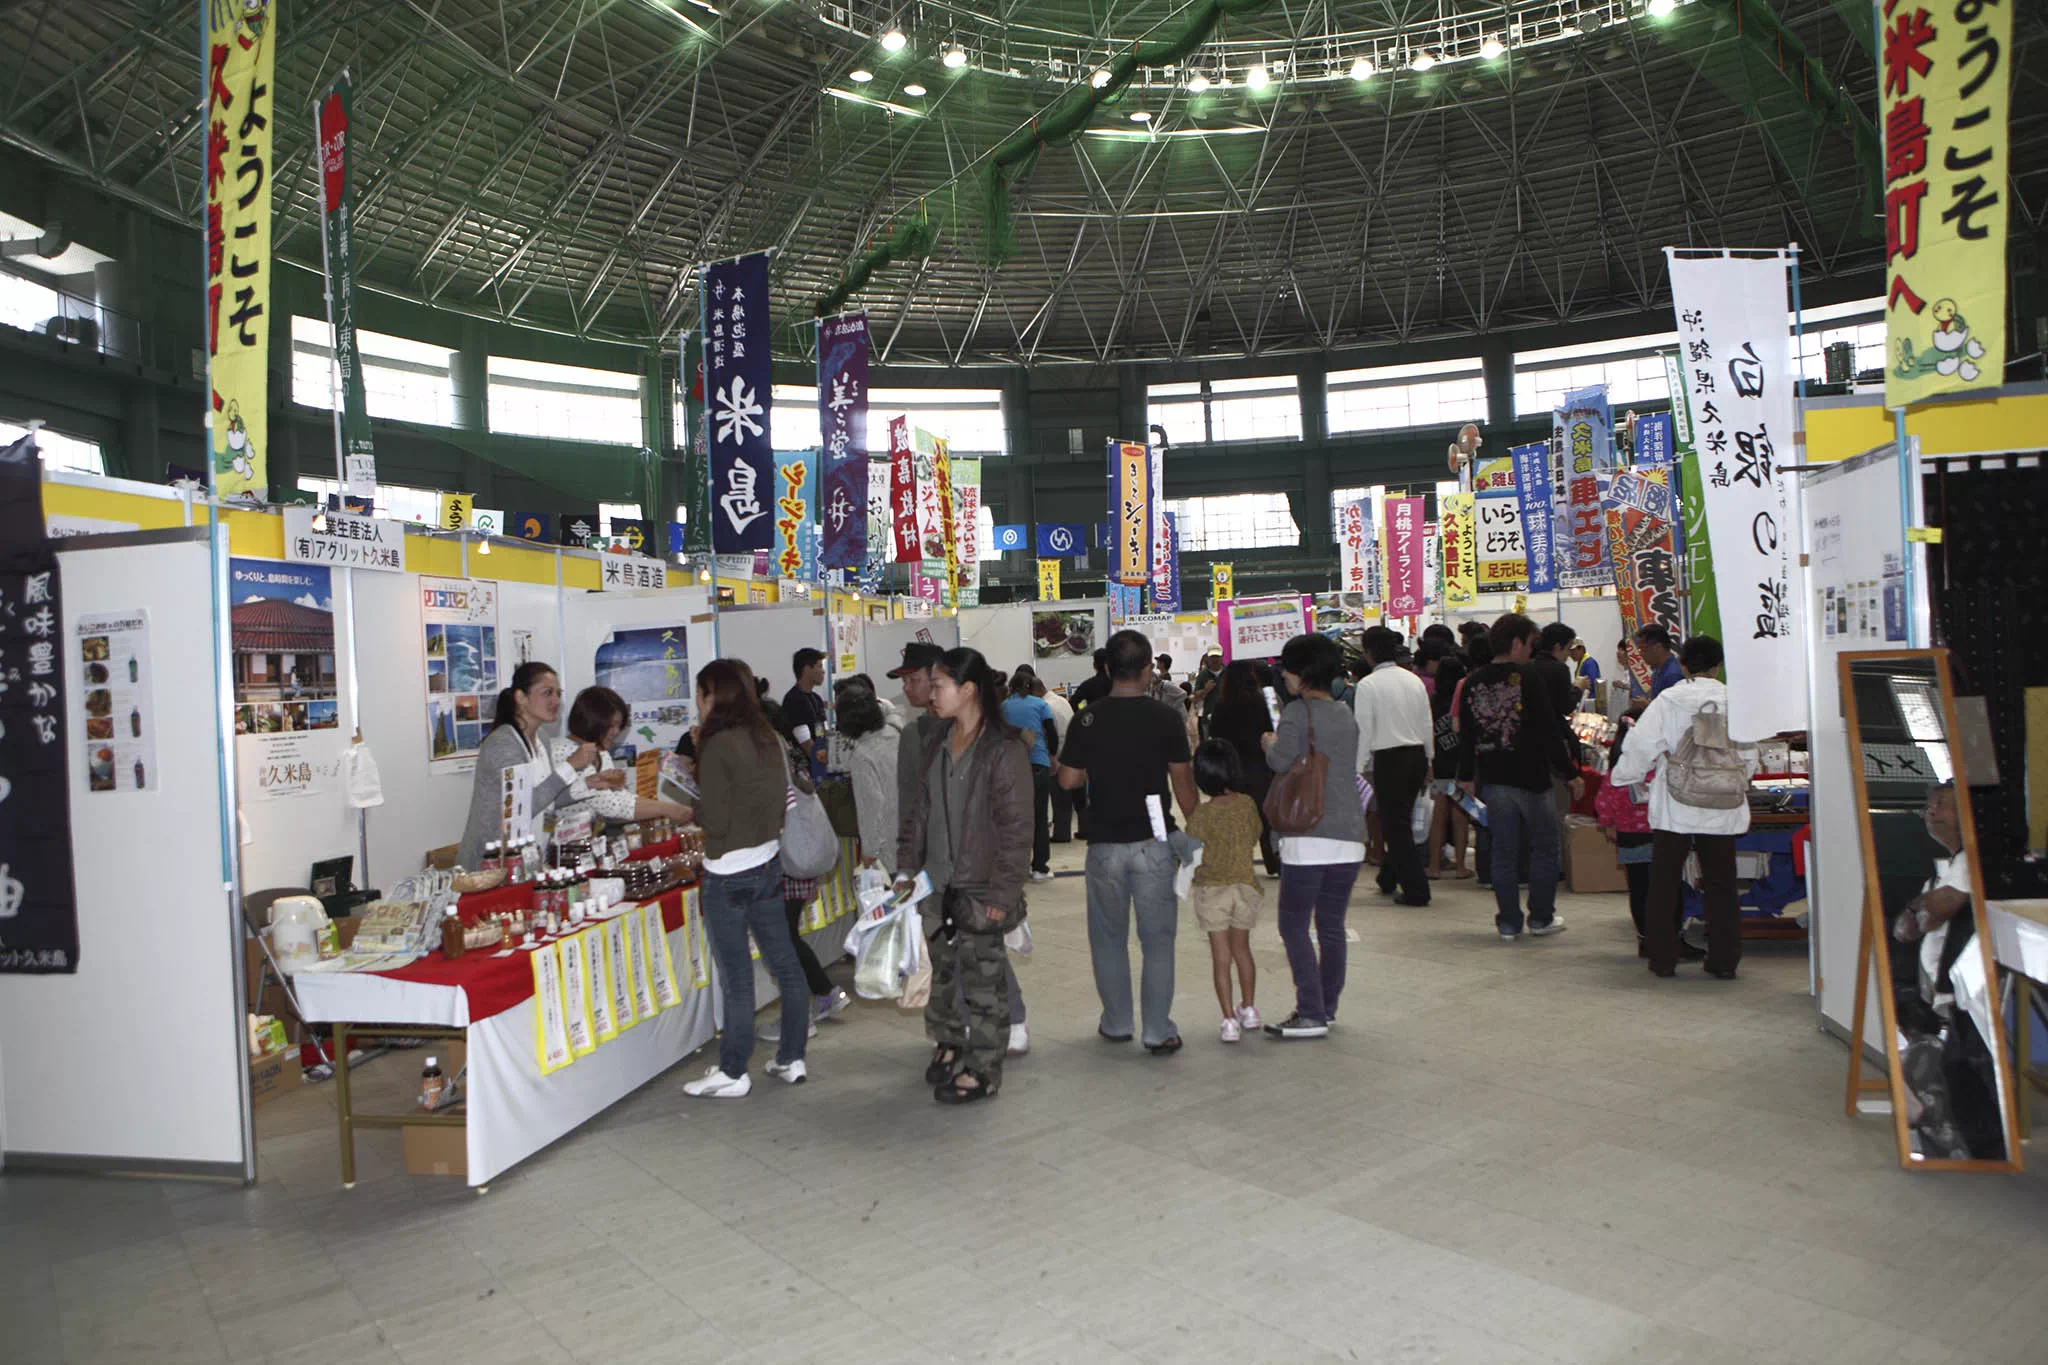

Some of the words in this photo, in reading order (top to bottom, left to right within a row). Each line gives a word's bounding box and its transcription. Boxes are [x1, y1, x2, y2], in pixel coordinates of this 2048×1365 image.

[1884, 0, 1937, 315] 米島町へ
[230, 77, 268, 346] ようこそ
[921, 485, 938, 534] ジャム
[963, 487, 977, 564] 琉球ばらいちご
[1481, 503, 1520, 525] いら
[294, 536, 400, 568] (有)アグリット久米島
[1395, 503, 1413, 593] 月桃アイランド
[1443, 512, 1461, 590] 久米島町へ
[1462, 524, 1474, 578] ようこそ
[1527, 511, 1548, 585] 球美の水
[25, 571, 57, 744] 風味豊かな
[268, 762, 312, 786] 久米島
